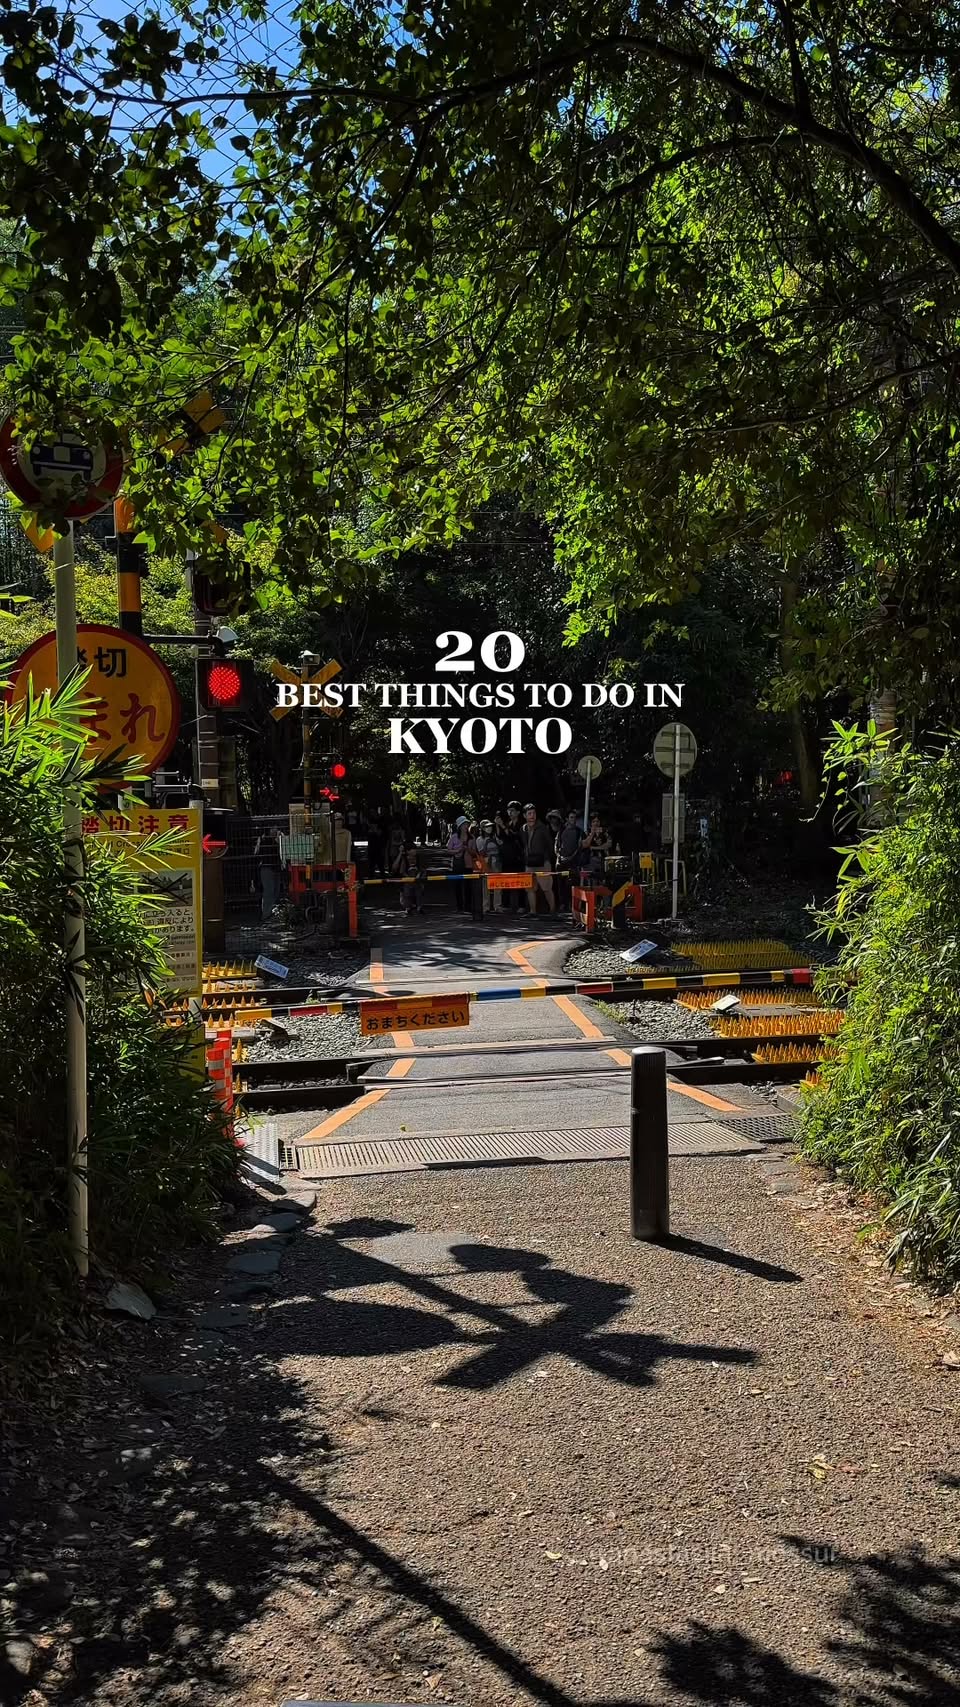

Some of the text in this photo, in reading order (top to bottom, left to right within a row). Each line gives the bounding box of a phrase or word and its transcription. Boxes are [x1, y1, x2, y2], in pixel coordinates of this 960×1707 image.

[73, 692, 166, 744] まれ
[81, 814, 189, 834] 踏切注意
[366, 1010, 465, 1031] おまちください
